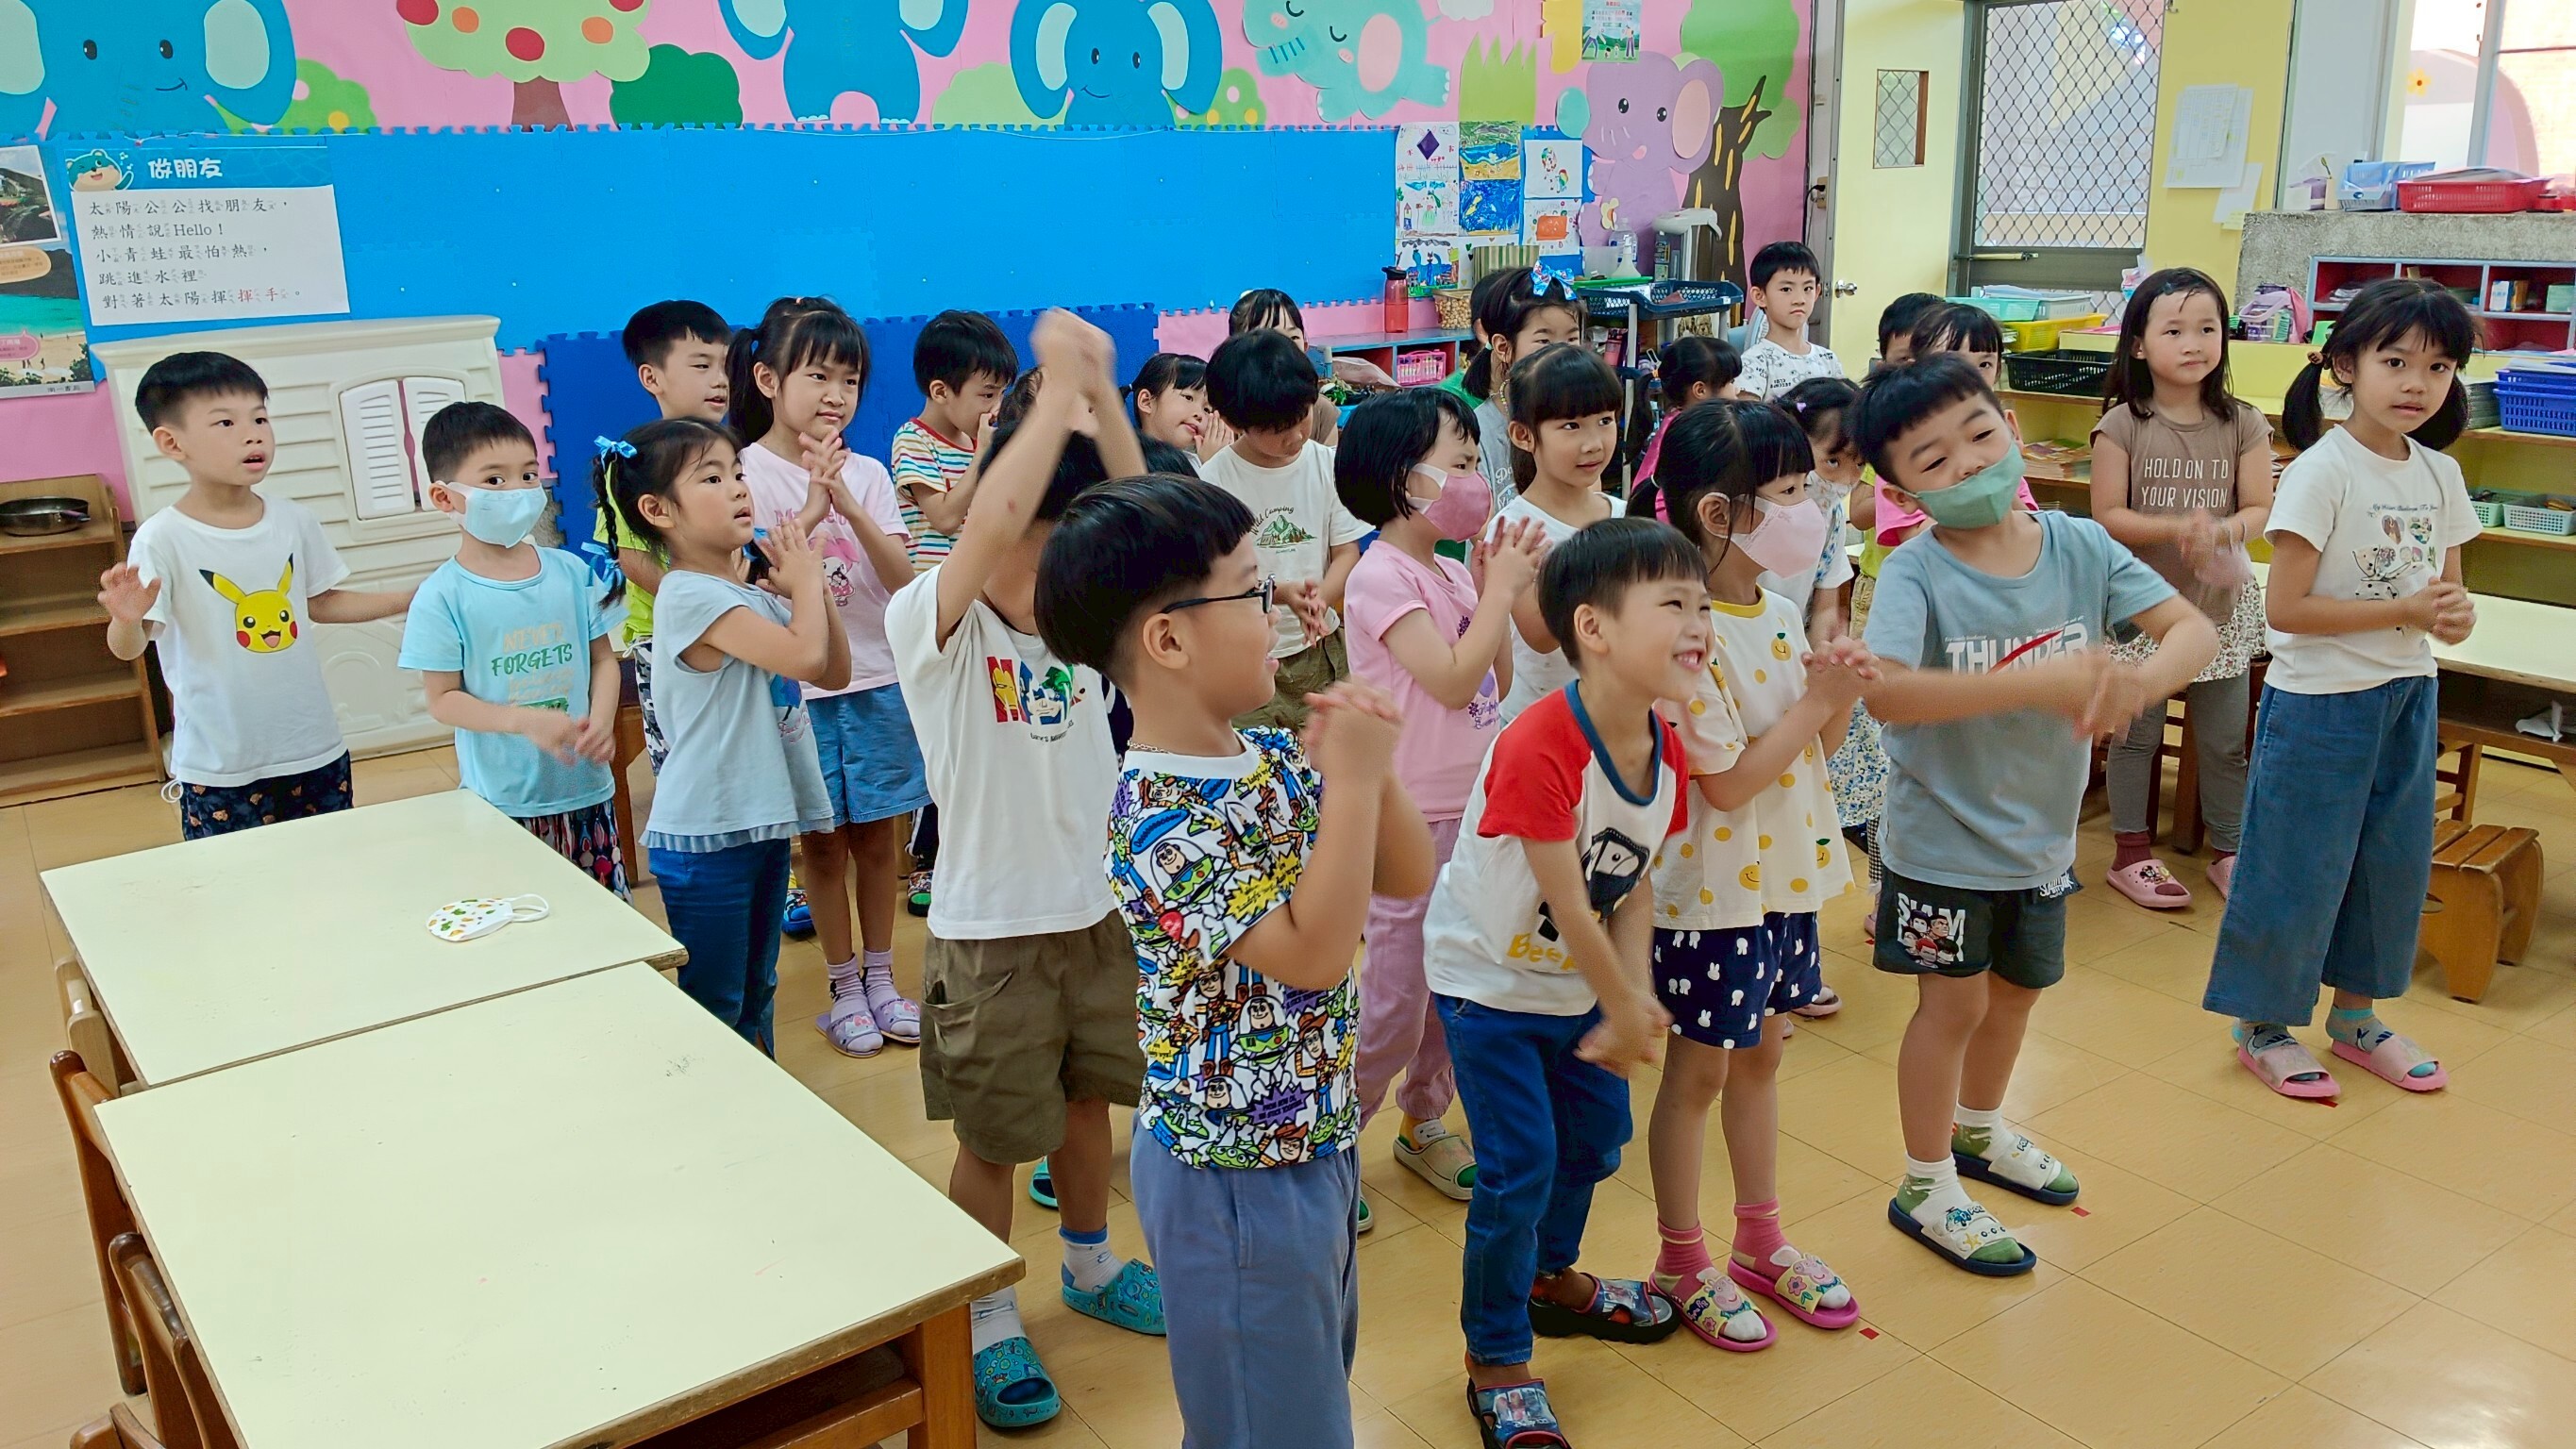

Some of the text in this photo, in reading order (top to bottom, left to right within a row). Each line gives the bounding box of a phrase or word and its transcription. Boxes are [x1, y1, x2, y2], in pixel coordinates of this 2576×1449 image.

[147, 158, 224, 179] 做朋友
[99, 269, 198, 285] 跳進水裡
[2144, 458, 2229, 479] HOLD ON TO
[2141, 487, 2228, 508] YOUR VISION
[1264, 505, 1295, 519] Camping
[491, 642, 573, 676] FORGETS
[1946, 622, 2089, 675] THUNDER
